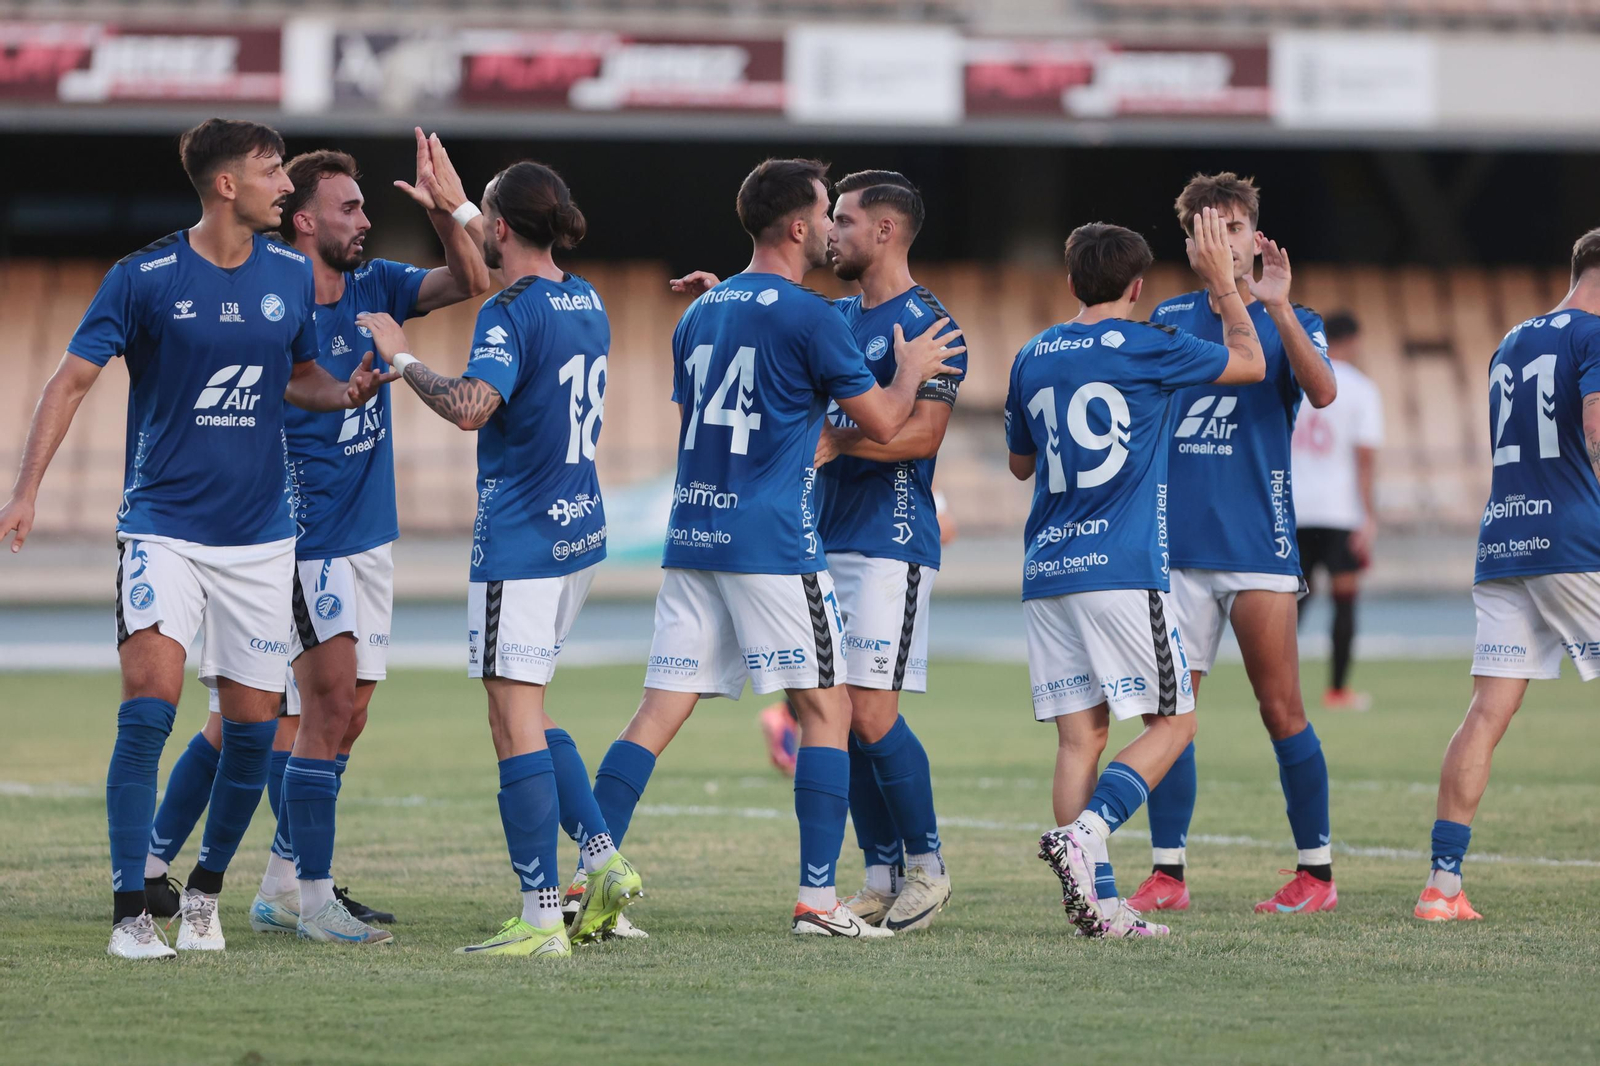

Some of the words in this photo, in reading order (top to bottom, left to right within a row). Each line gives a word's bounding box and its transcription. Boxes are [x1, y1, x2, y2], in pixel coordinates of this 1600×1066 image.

[221, 302, 239, 315] L3G
[546, 291, 593, 311] indeso
[1034, 336, 1094, 357] indeso
[222, 388, 261, 410] Air
[558, 353, 608, 464] 18
[684, 344, 762, 456] 14
[195, 413, 256, 427] oneair.es
[1489, 354, 1561, 467] 21
[1027, 381, 1131, 494] 19
[1200, 417, 1238, 440] Air
[1178, 441, 1233, 456] oneair.es
[1270, 469, 1286, 533] FoxField
[1156, 483, 1169, 549] FoxField
[570, 538, 586, 553] san
[691, 527, 731, 545] benito
[1486, 541, 1507, 555] san
[1508, 536, 1551, 552] benito
[1037, 560, 1060, 573] san
[1062, 552, 1109, 569] benito
[1512, 549, 1533, 558] DENTAL
[1067, 566, 1089, 575] DENTAL
